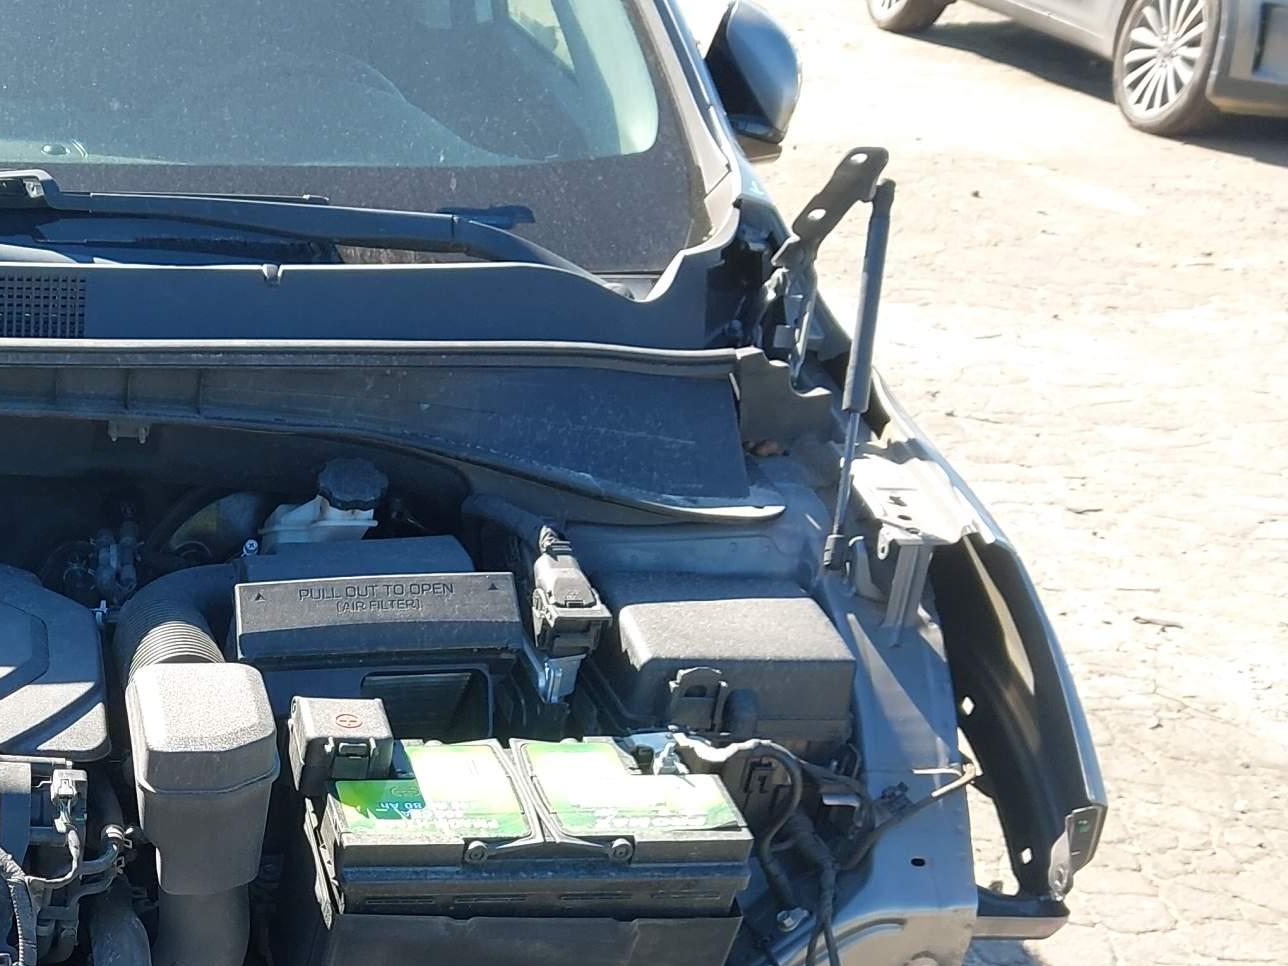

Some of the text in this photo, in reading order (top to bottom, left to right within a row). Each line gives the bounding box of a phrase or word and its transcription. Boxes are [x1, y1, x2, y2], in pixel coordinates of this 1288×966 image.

[298, 582, 454, 601] PULL OUT TO OPEN
